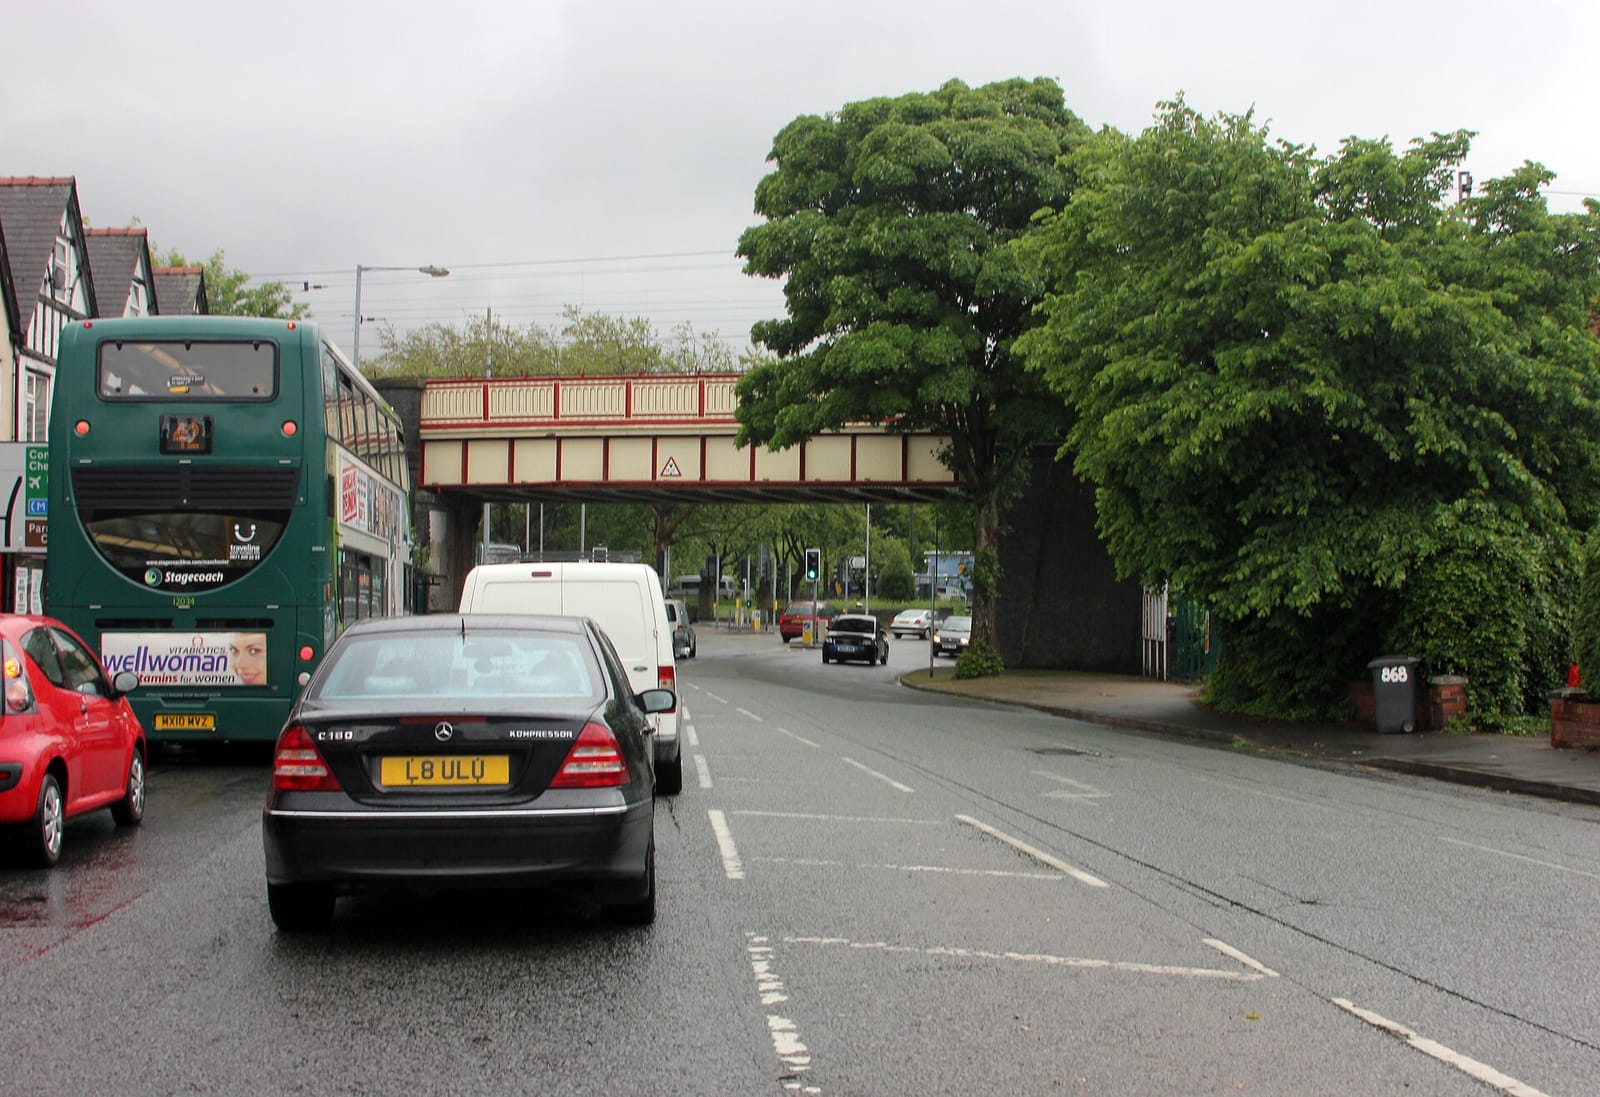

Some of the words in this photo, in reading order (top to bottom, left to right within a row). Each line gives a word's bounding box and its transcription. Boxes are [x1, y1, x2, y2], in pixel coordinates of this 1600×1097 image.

[173, 421, 201, 448] 42
[165, 571, 223, 585] Stagecoach
[103, 646, 228, 672] wellwoman
[180, 674, 192, 684] for
[195, 675, 235, 683] women
[1382, 666, 1408, 682] 868
[162, 716, 185, 726] MX10
[188, 716, 208, 726] MVZ
[318, 731, 326, 740] C
[330, 731, 353, 740] 180
[510, 730, 573, 738] KOMPRESSOR
[406, 760, 434, 780] L8
[441, 760, 485, 780] ULU
